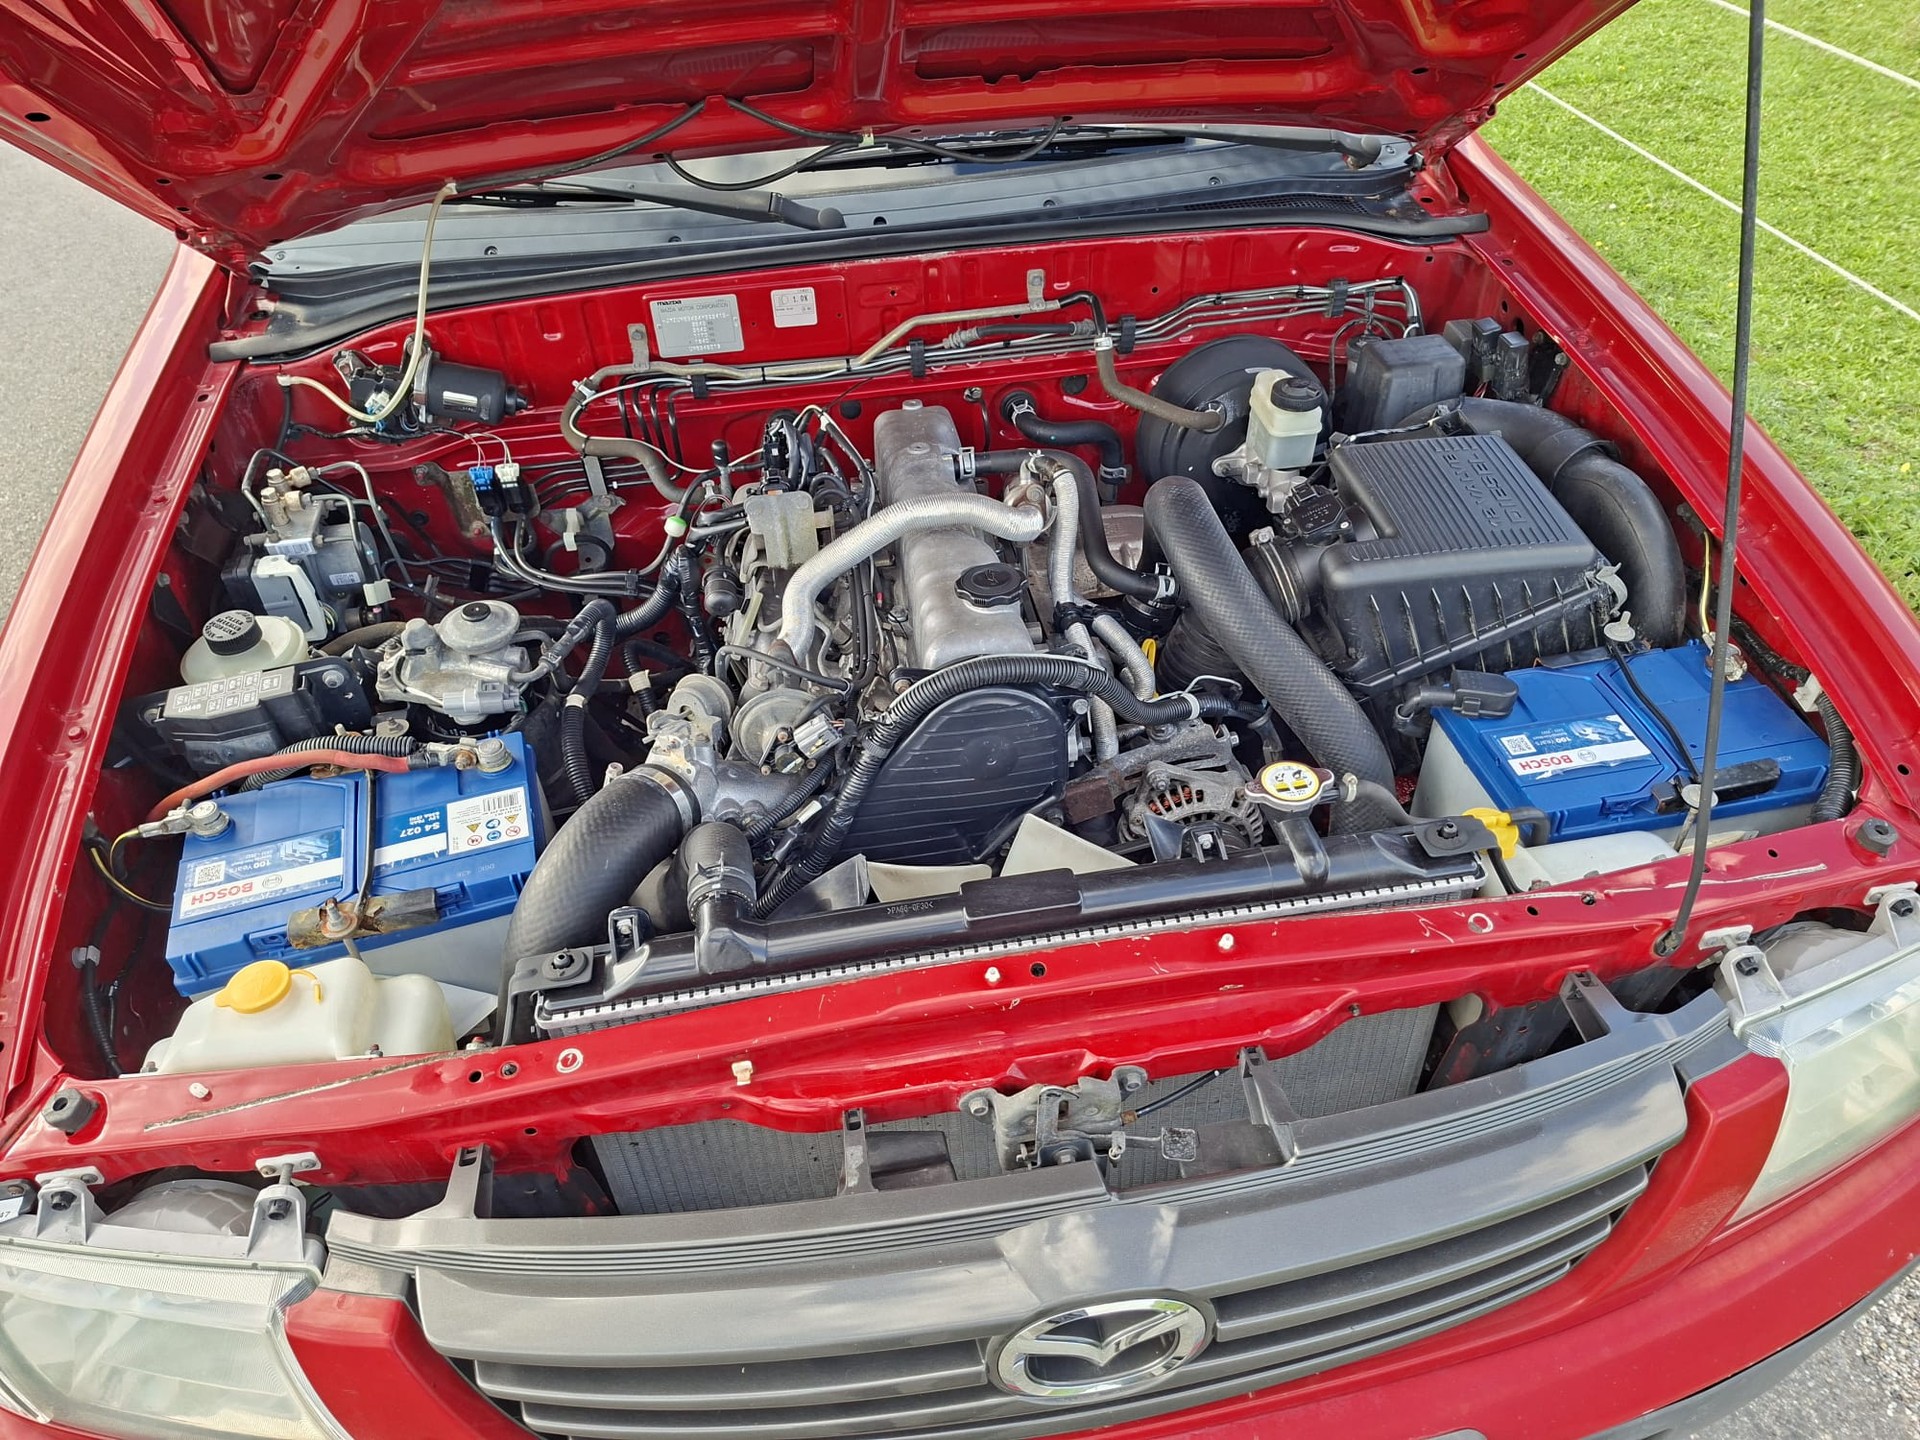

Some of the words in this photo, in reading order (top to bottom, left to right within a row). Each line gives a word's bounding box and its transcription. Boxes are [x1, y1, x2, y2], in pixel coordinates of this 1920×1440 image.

[696, 302, 729, 310] CORPORATION
[1468, 453, 1528, 522] DIESEL
[1556, 736, 1572, 744] 100
[1519, 755, 1573, 771] BOSCH
[400, 826, 421, 837] 027
[424, 822, 440, 831] S4
[254, 860, 272, 869] 100
[191, 882, 253, 906] BOSCH
